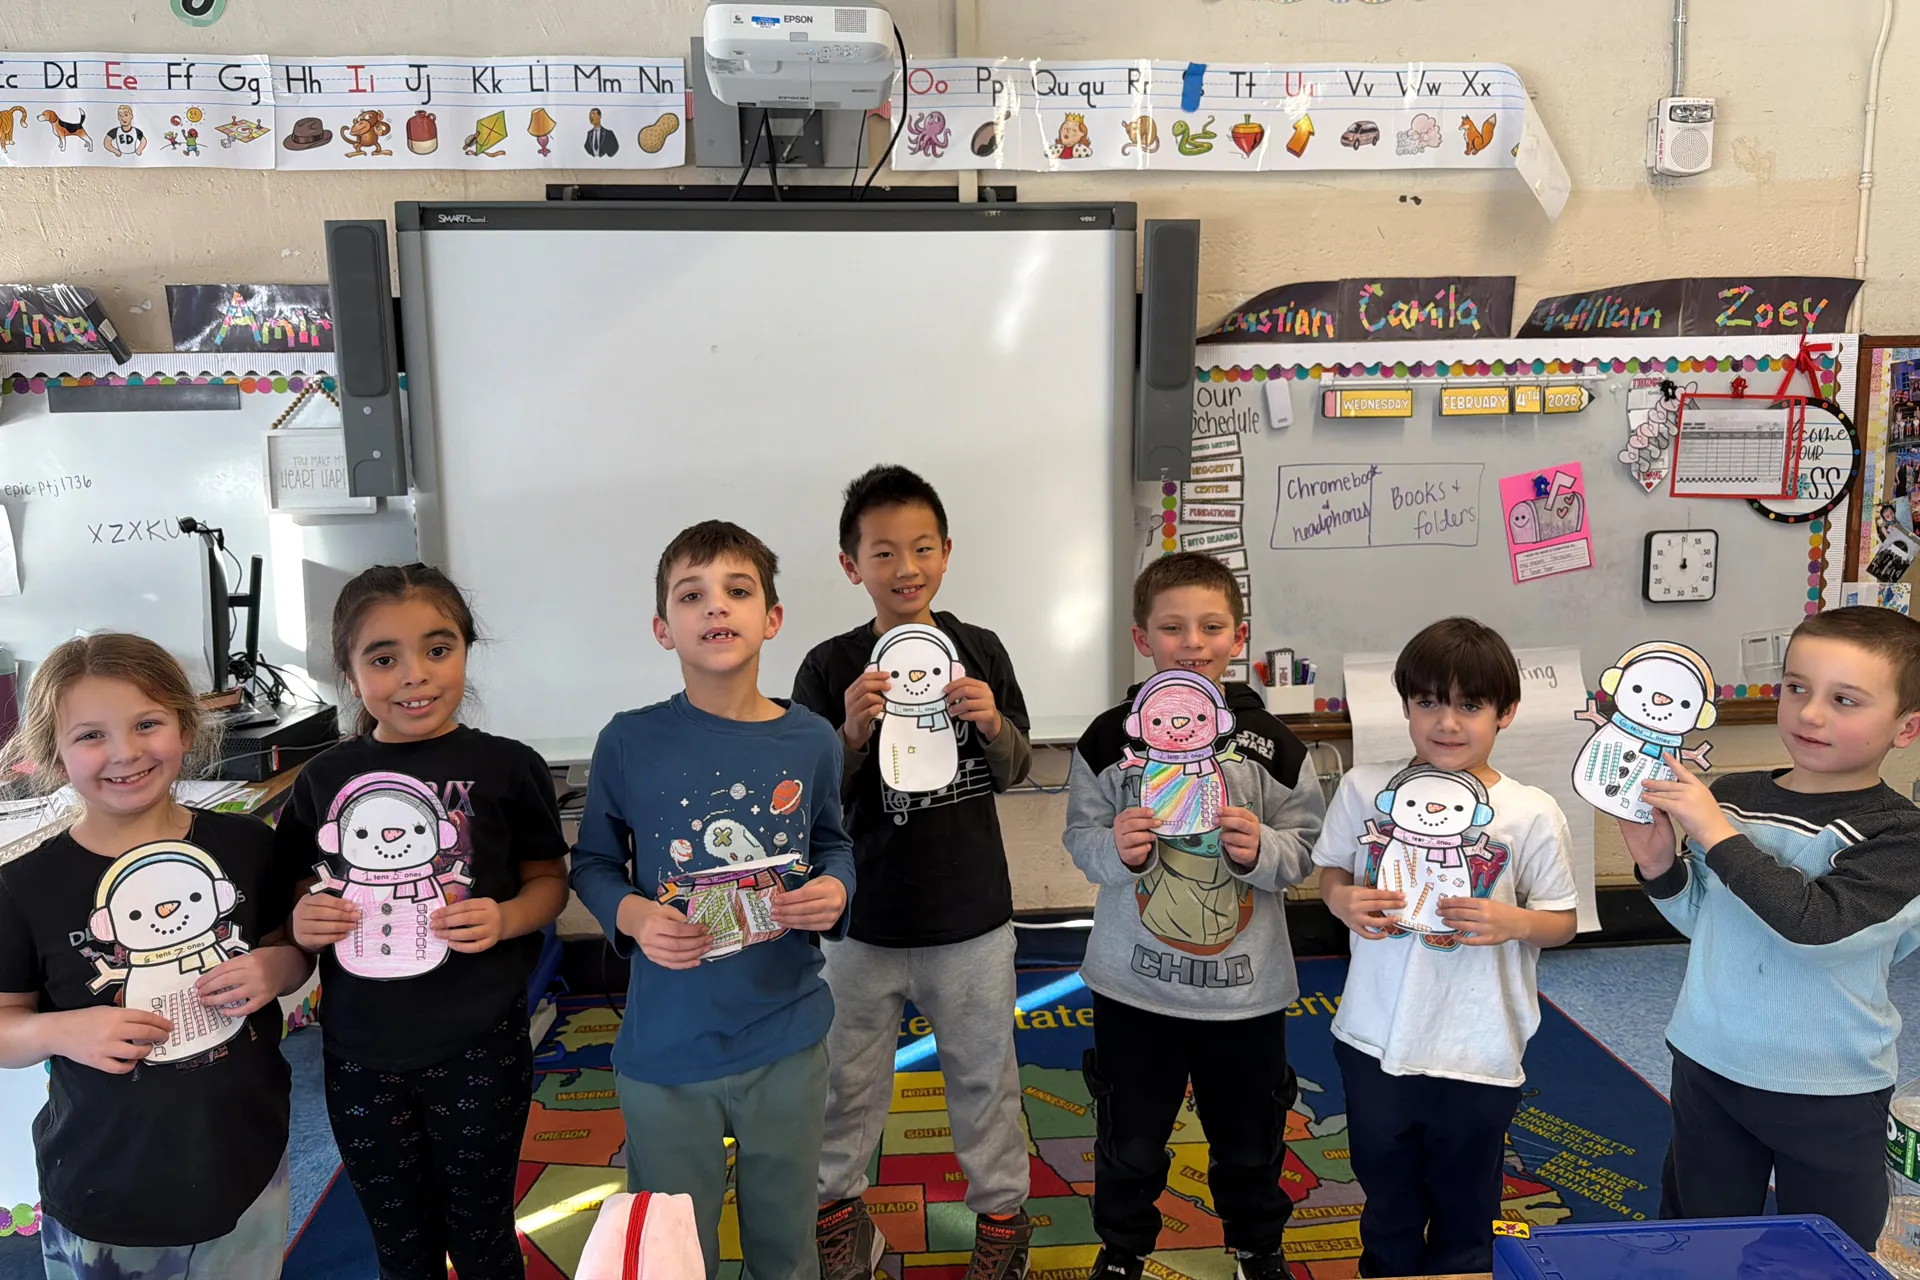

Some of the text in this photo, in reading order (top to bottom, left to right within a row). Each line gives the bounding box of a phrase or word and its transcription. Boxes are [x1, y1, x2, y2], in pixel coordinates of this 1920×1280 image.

[784, 15, 813, 23] EPSON
[44, 61, 78, 89] Dd
[105, 61, 138, 90] Ee
[167, 62, 195, 90] Ff
[218, 64, 261, 105] Gg
[286, 65, 322, 93] Hh
[405, 64, 431, 105] Jj
[472, 66, 503, 94] Kk
[574, 64, 621, 92] Mm
[639, 66, 674, 93] Nn
[908, 68, 948, 94] Oo
[1461, 71, 1491, 97] Xx
[119, 134, 133, 145] ED
[438, 214, 467, 223] SMART
[1359, 283, 1480, 332] Camila
[1544, 295, 1662, 331] William
[1715, 285, 1828, 334] Zoey
[1343, 398, 1409, 411] WEDNESDAY
[1442, 394, 1508, 410] FEBRUARY
[1547, 394, 1578, 408] 2026
[1414, 506, 1476, 540] folders
[1236, 730, 1275, 751] STAR
[156, 951, 172, 960] tens
[187, 942, 205, 951] ones
[1130, 943, 1254, 989] CHILD
[576, 1024, 620, 1033] ALASK
[904, 1088, 945, 1098] NORTH
[1023, 1086, 1087, 1117] MINNESOTA
[535, 1129, 590, 1140] OREGON
[906, 1128, 950, 1138] SOUTH
[1511, 1117, 1602, 1159] CONNECTICUT
[1518, 1112, 1614, 1156] RHODE ISLAND
[1527, 1107, 1636, 1156] MASSACHUSETTS
[1542, 1162, 1623, 1201] MARYLAND
[1550, 1157, 1627, 1193] DELAWARE
[1559, 1151, 1648, 1192] NEW JERSEY
[1535, 1167, 1631, 1215] WASHINGTON
[1293, 1204, 1365, 1219] KENTUCKY
[978, 1223, 1016, 1235] SKECHERS
